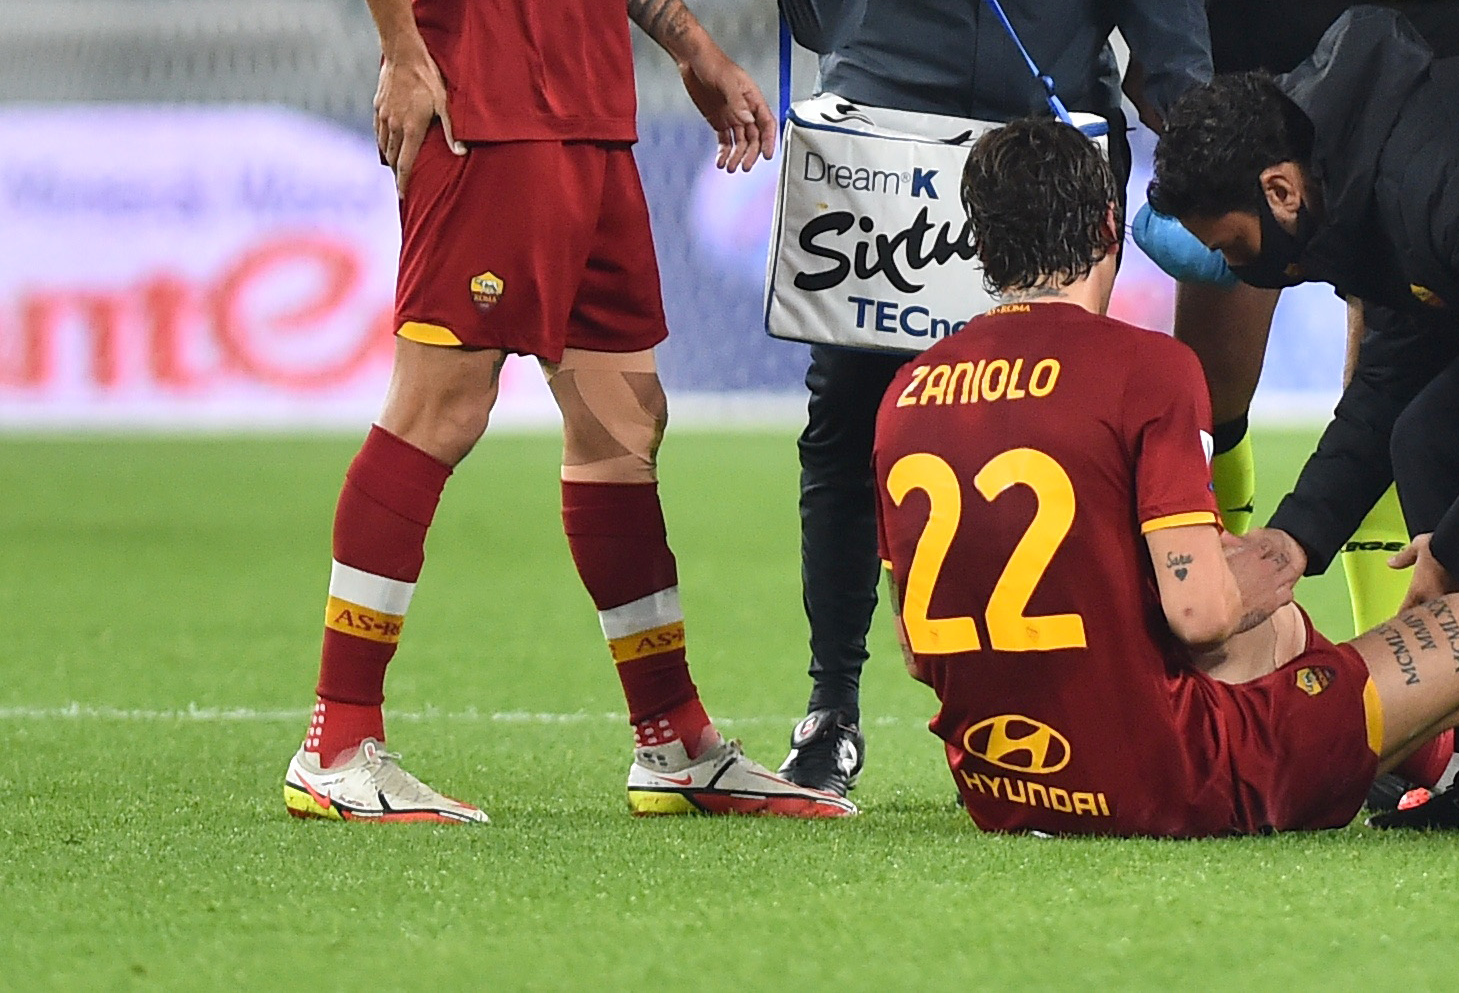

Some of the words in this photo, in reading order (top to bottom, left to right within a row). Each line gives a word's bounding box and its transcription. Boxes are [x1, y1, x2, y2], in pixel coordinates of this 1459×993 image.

[895, 357, 1062, 409] ZANIOLO
[886, 447, 1088, 655] 22
[960, 768, 1112, 818] HYUNDAI
